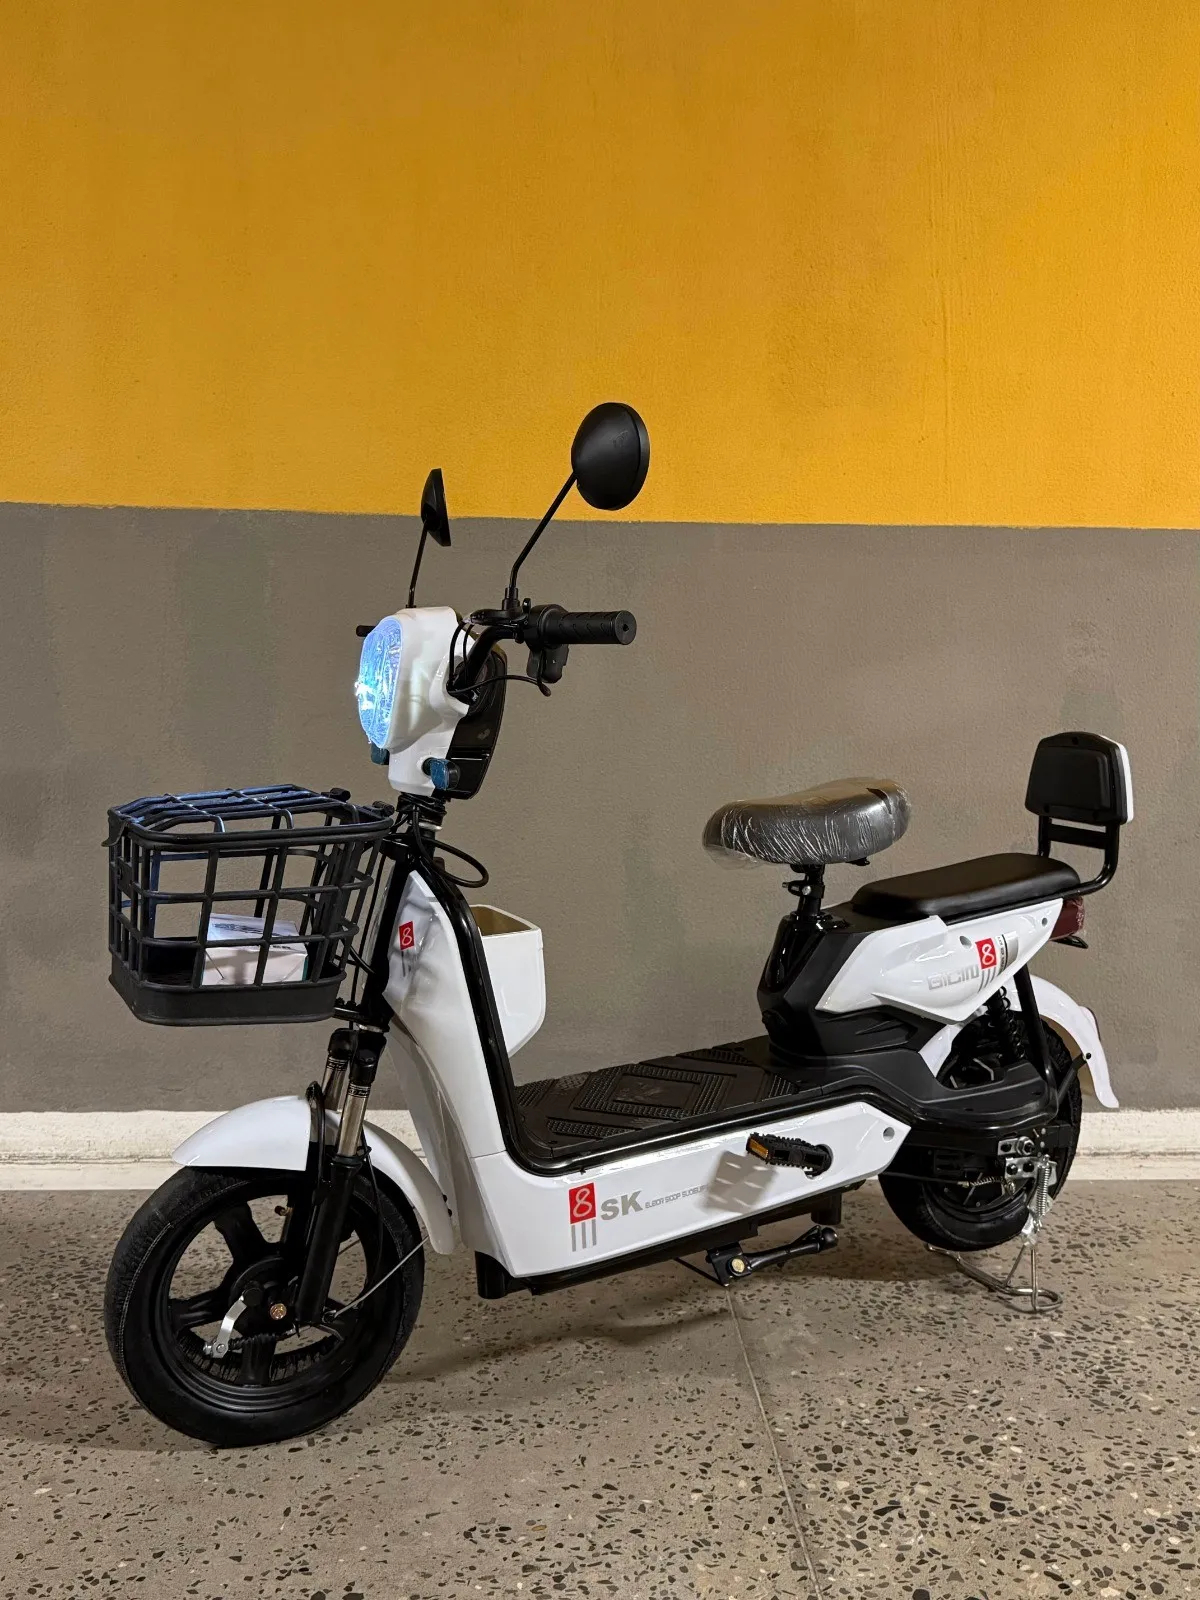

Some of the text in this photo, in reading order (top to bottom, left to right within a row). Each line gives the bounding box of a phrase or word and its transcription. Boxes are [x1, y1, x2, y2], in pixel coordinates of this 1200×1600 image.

[401, 927, 412, 946] 8
[982, 943, 995, 966] 8
[572, 1187, 593, 1218] 8
[600, 1190, 643, 1221] SK
